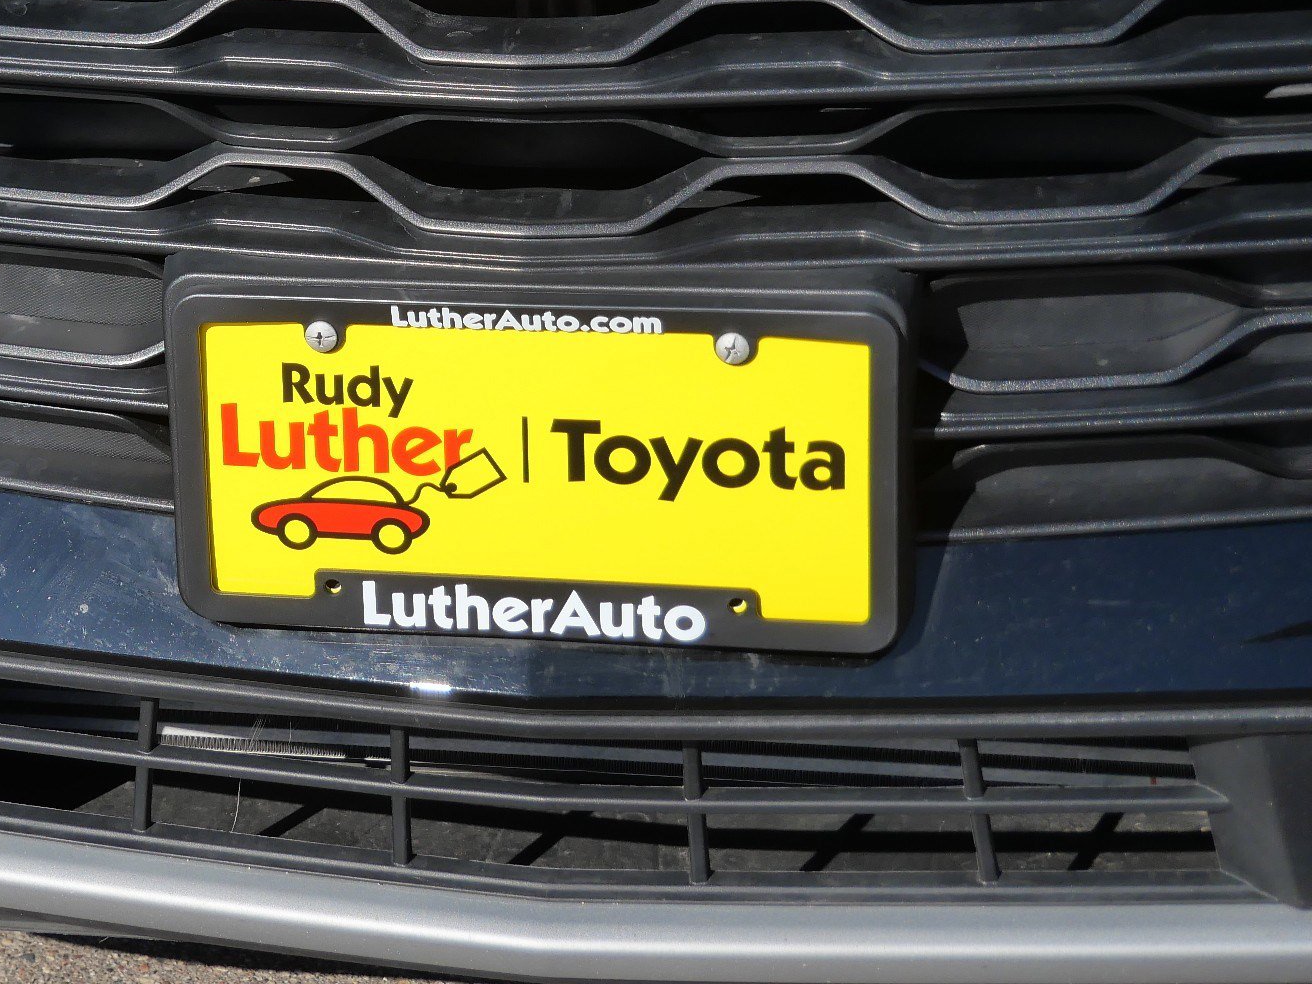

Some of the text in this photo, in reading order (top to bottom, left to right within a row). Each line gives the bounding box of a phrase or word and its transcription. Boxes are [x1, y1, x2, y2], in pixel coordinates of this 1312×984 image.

[390, 305, 663, 334] LutherAuto.com
[282, 363, 414, 418] Rudy
[220, 403, 473, 476] Luther
[551, 418, 846, 501] Toyota
[362, 580, 706, 642] LutherAuto
